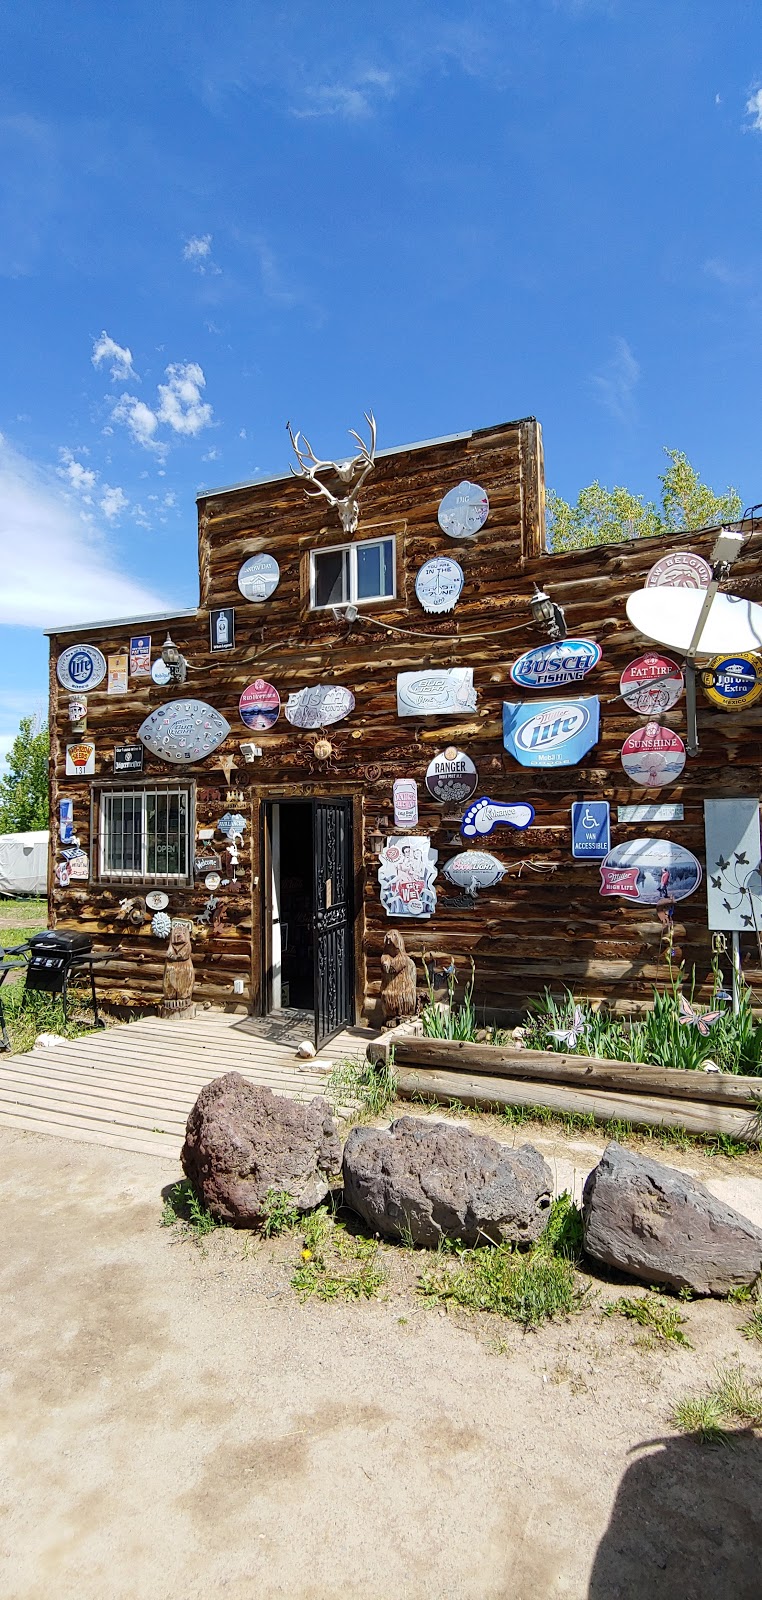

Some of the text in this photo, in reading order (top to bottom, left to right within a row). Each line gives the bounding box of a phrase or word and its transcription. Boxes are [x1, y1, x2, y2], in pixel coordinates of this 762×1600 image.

[665, 557, 709, 590] BELGIUM
[518, 655, 594, 675] BUSCH
[537, 671, 583, 683] FISHING
[630, 667, 649, 677] FAT
[724, 684, 748, 692] Extra
[287, 692, 346, 707] BUSCH
[536, 710, 570, 725] Miller
[527, 715, 579, 749] Lite
[628, 738, 678, 749] SUNSHINE
[75, 766, 86, 775] 131
[434, 761, 467, 773] RANGER
[157, 845, 176, 853] OPEN
[575, 842, 608, 850] ACCESSIBLE
[195, 859, 217, 869] Welcome
[607, 872, 632, 884] Miller
